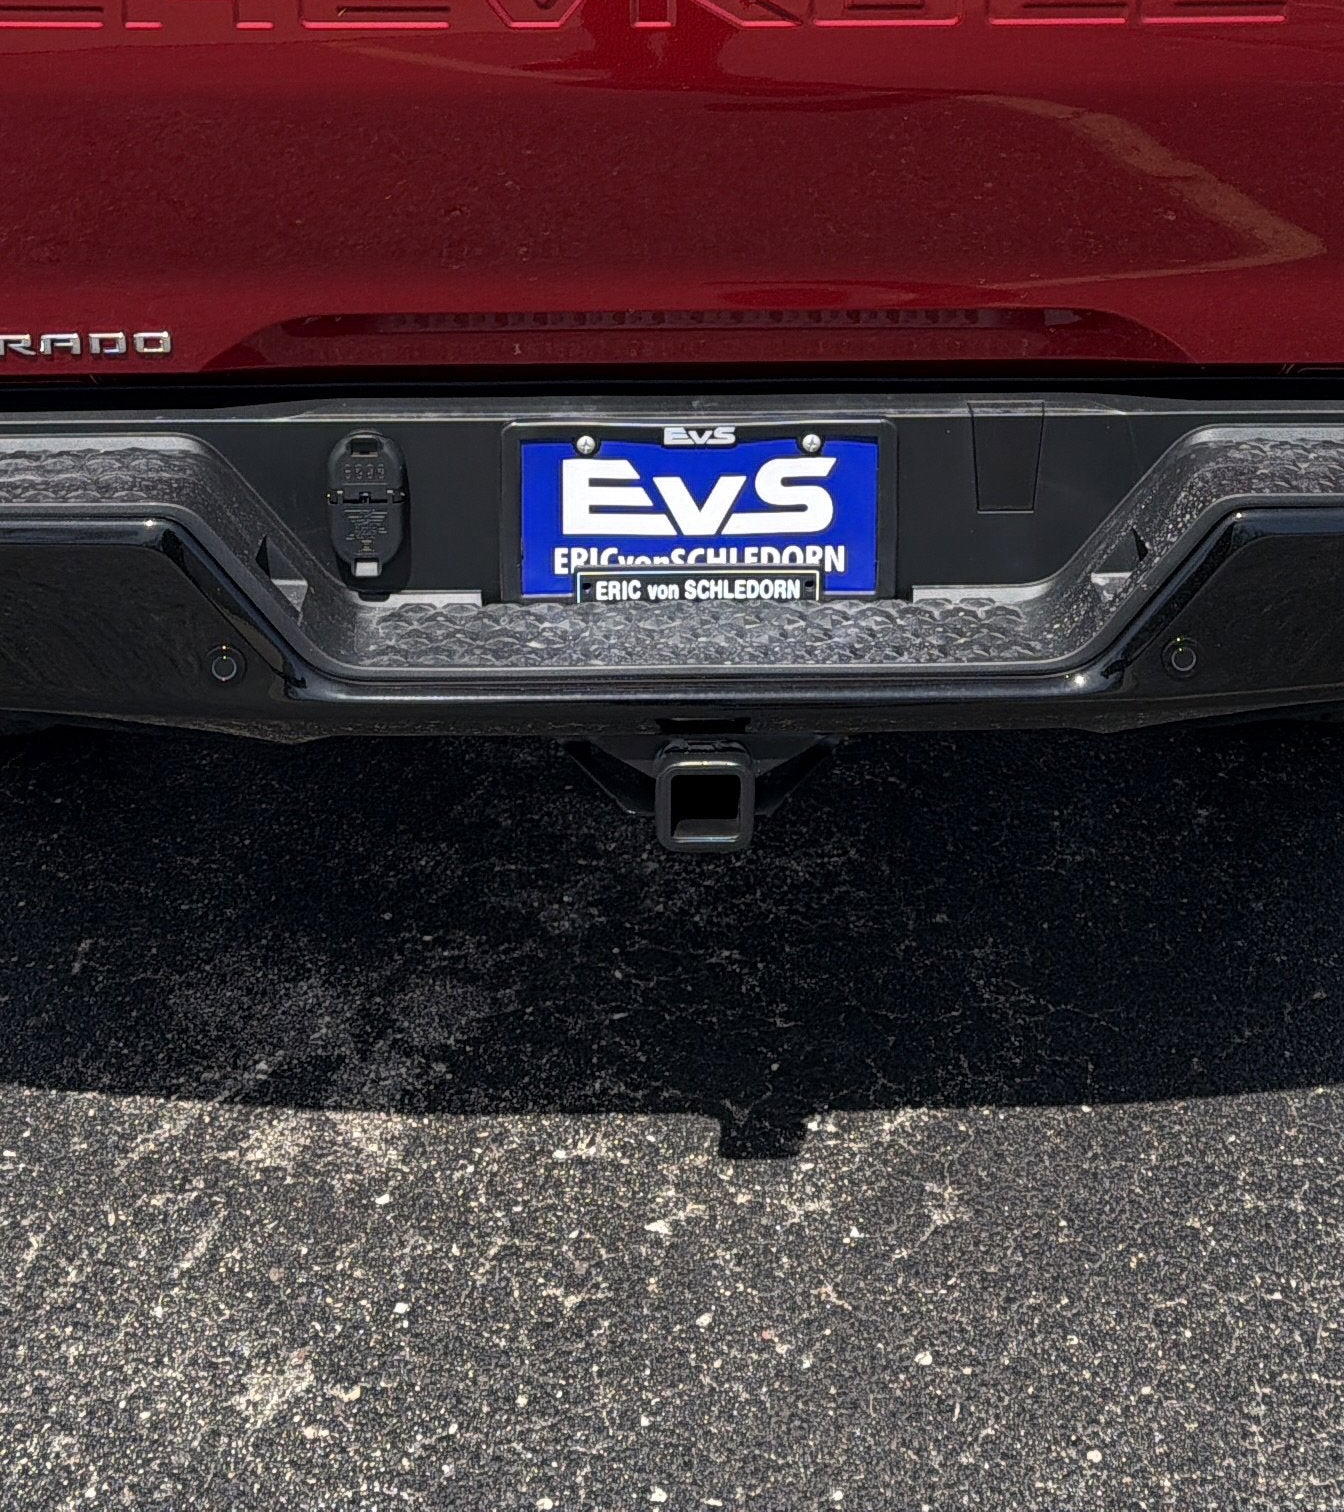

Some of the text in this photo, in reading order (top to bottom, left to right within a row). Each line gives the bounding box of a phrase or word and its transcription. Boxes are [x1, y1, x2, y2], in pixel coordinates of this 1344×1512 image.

[596, 579, 801, 601] ERIC von SCHLEDORN
